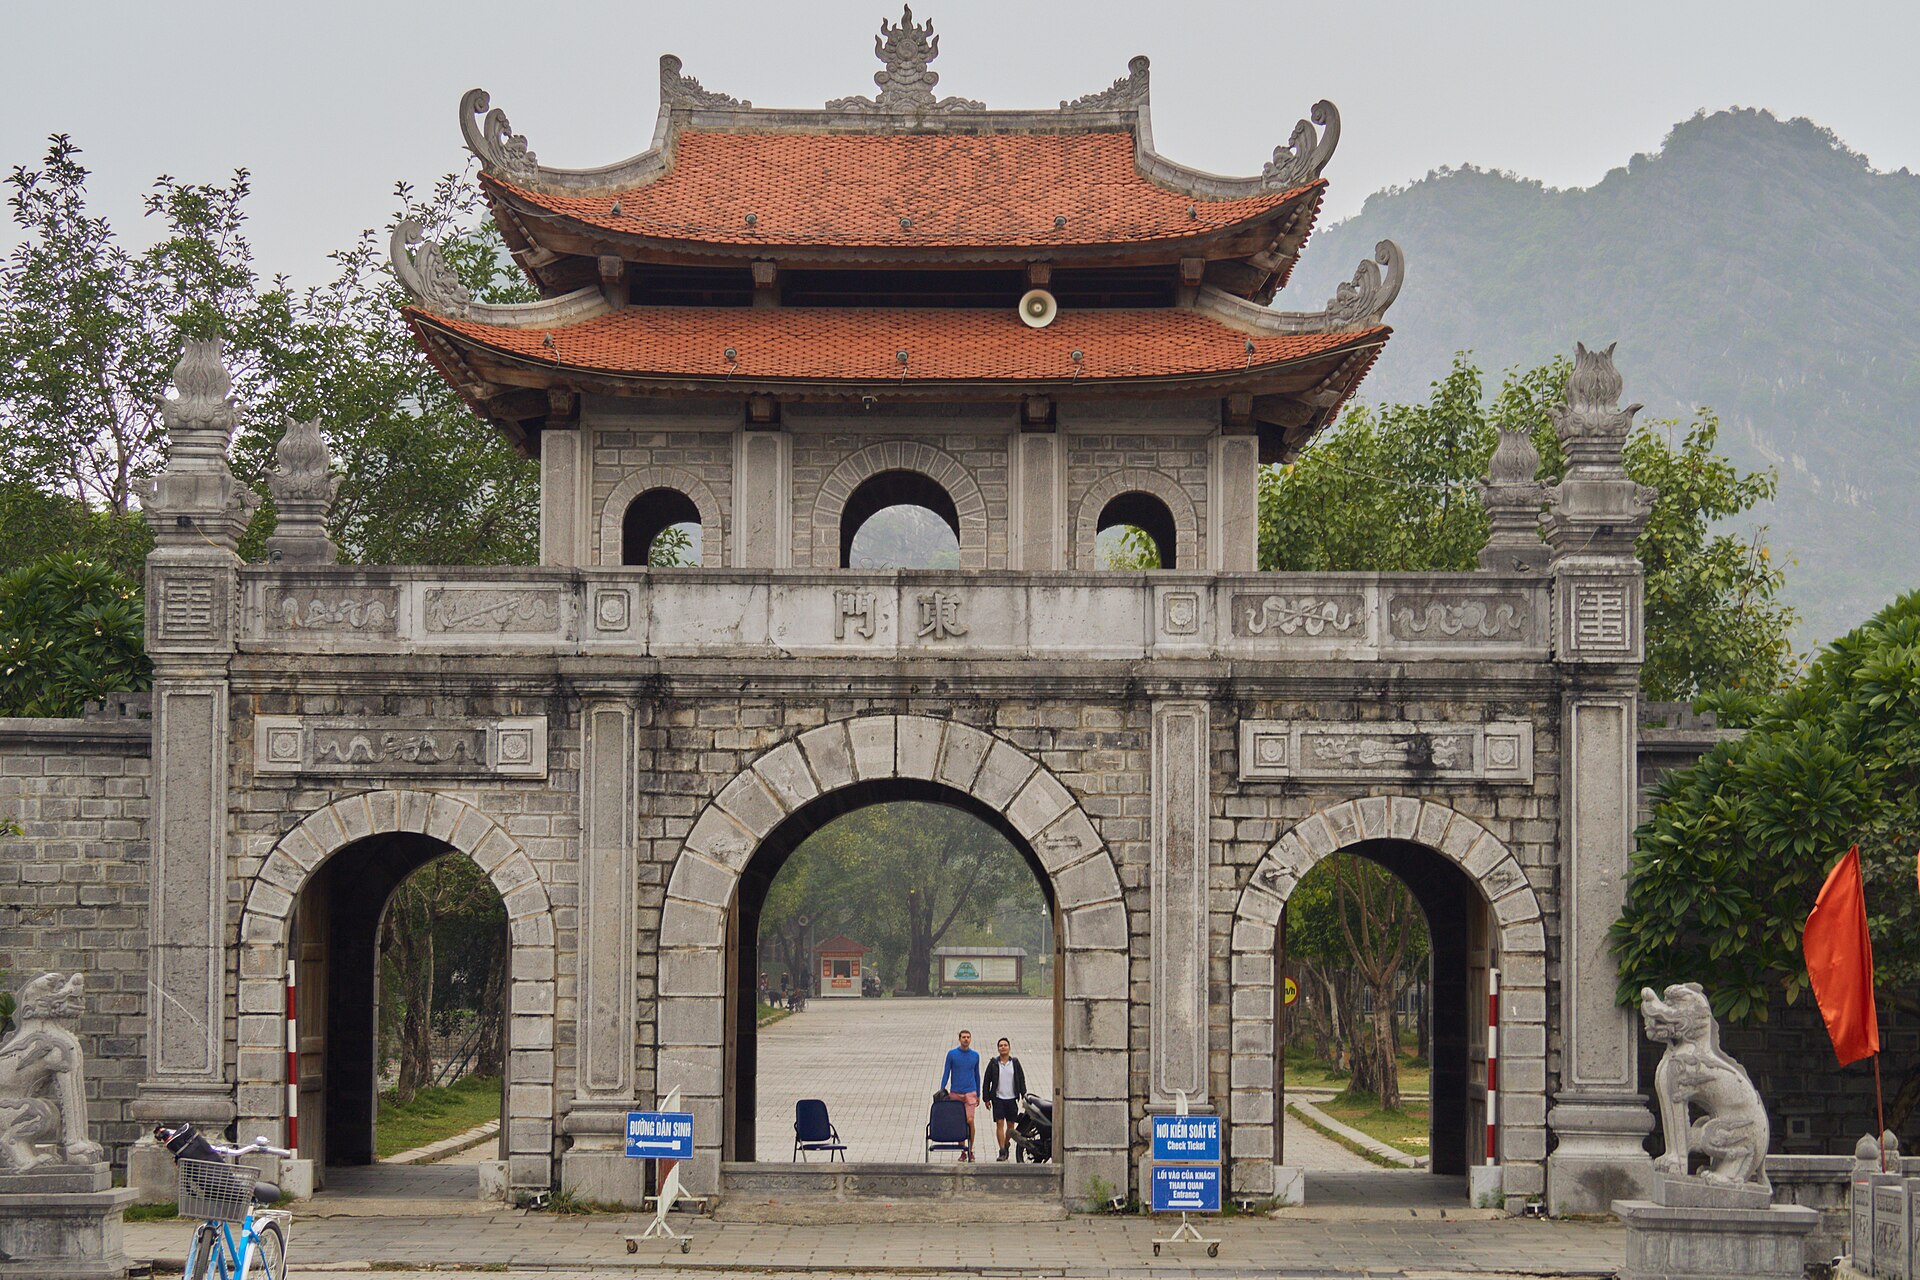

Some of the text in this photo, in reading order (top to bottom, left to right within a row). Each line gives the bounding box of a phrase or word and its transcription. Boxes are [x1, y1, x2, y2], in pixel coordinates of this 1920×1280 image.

[673, 1122, 691, 1137] SINH
[1189, 1121, 1207, 1139] SOÁT
[1167, 1141, 1205, 1150] Check Ticket
[1169, 1182, 1204, 1190] THAM QUAN
[1173, 1190, 1200, 1199] Entrance
